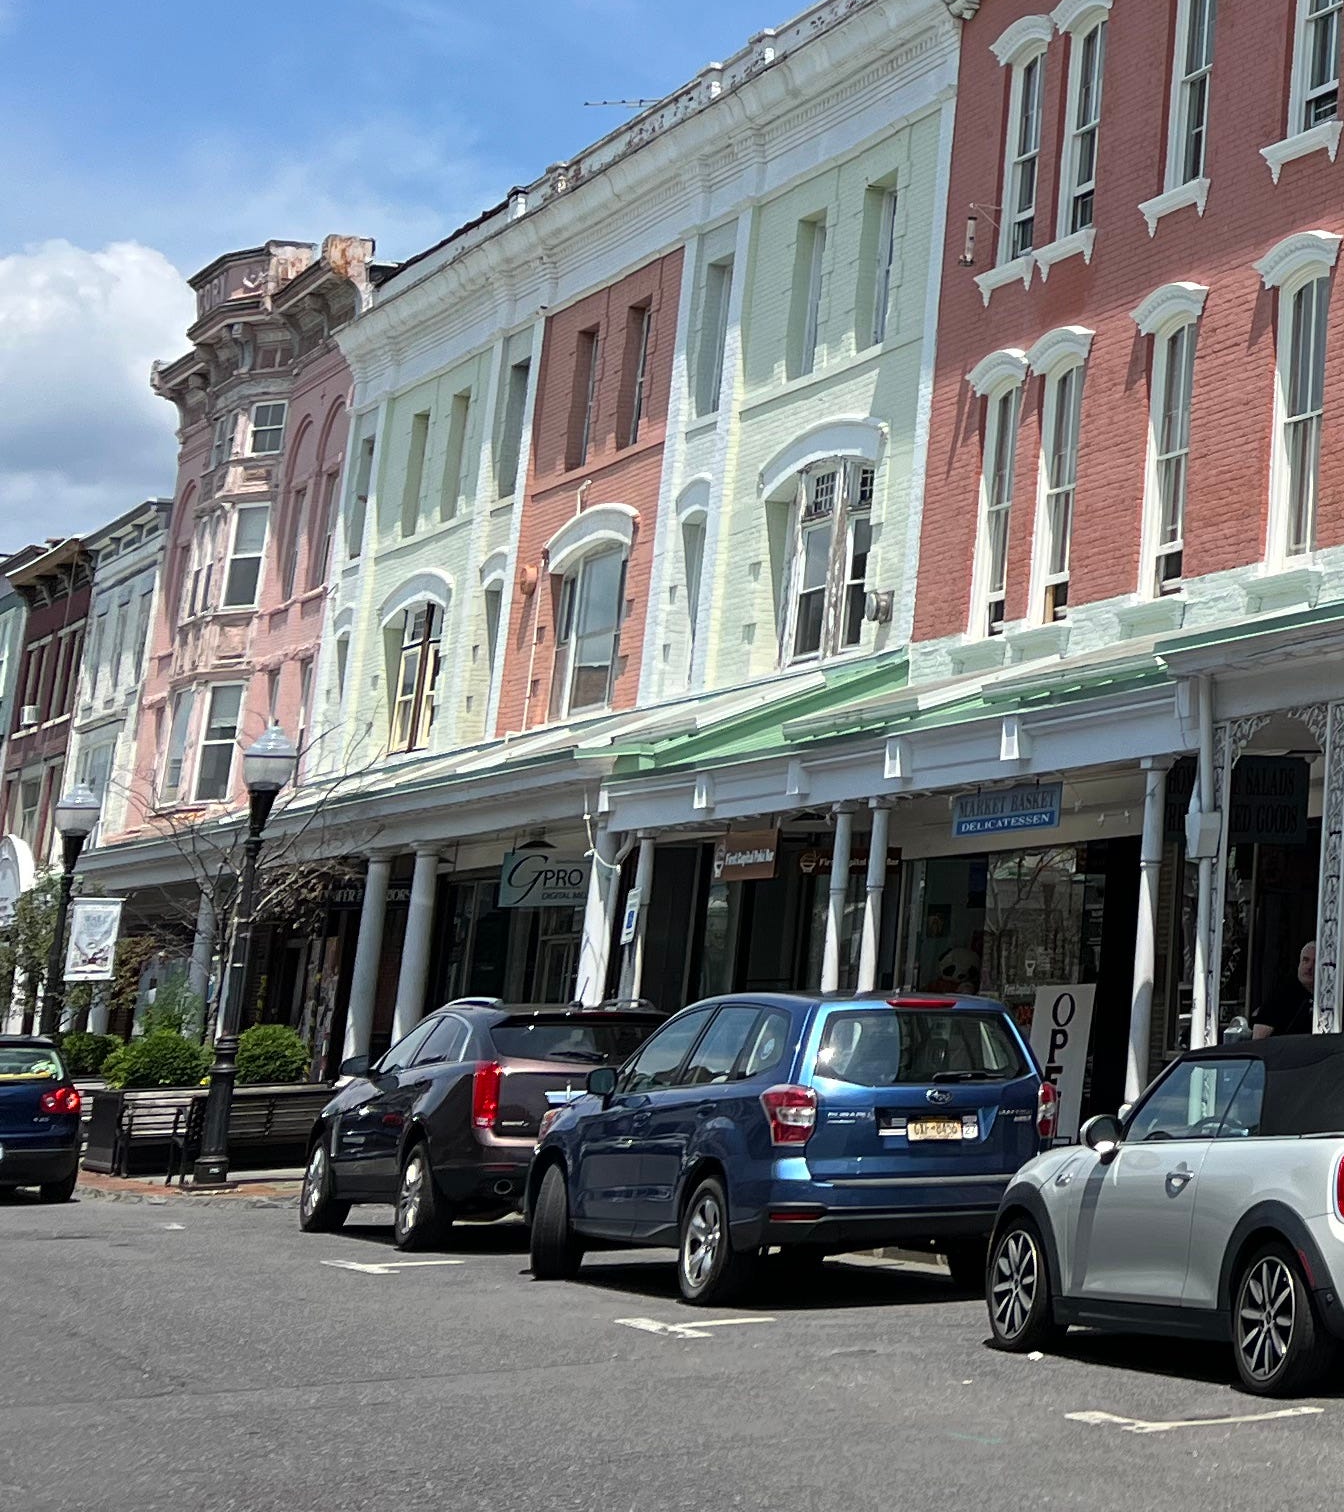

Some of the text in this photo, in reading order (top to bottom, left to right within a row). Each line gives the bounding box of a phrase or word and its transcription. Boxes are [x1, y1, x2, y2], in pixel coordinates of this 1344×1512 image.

[959, 790, 1057, 818] MARKET BASKET
[961, 813, 1051, 833] DELICATESSEN
